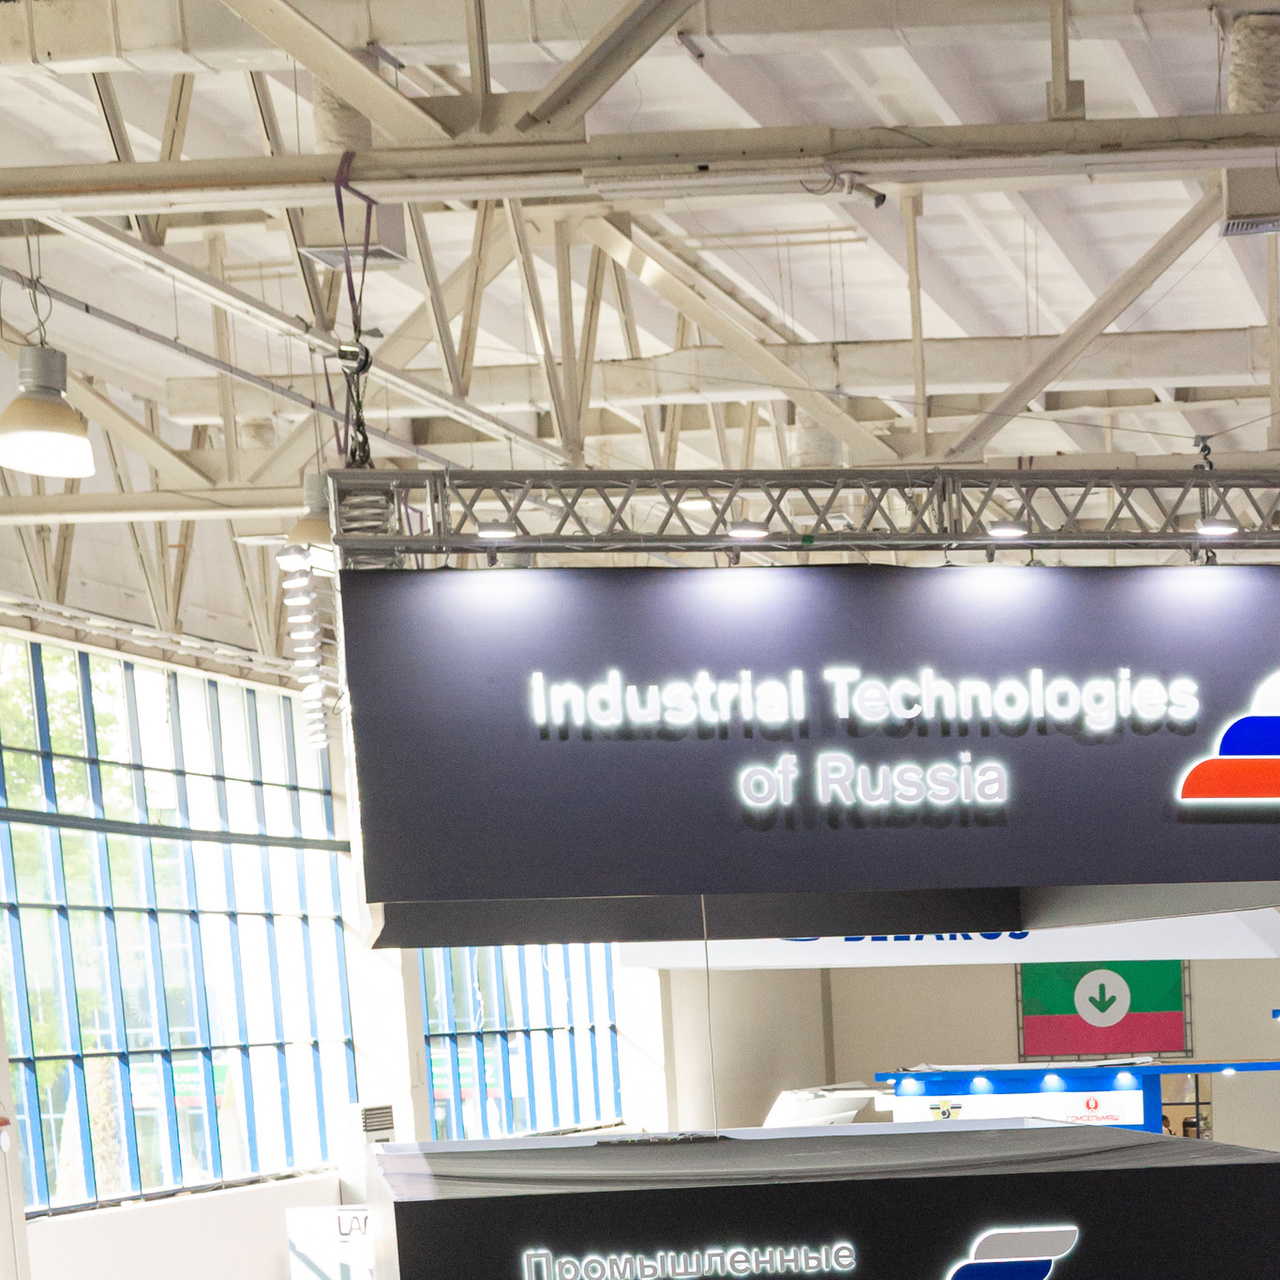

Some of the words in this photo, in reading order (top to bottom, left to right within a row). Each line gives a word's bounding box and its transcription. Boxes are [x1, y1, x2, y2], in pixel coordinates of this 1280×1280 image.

[531, 668, 805, 726] Industrial
[824, 667, 1200, 730] Technologies
[740, 753, 798, 806] of
[818, 752, 1008, 805] Russia
